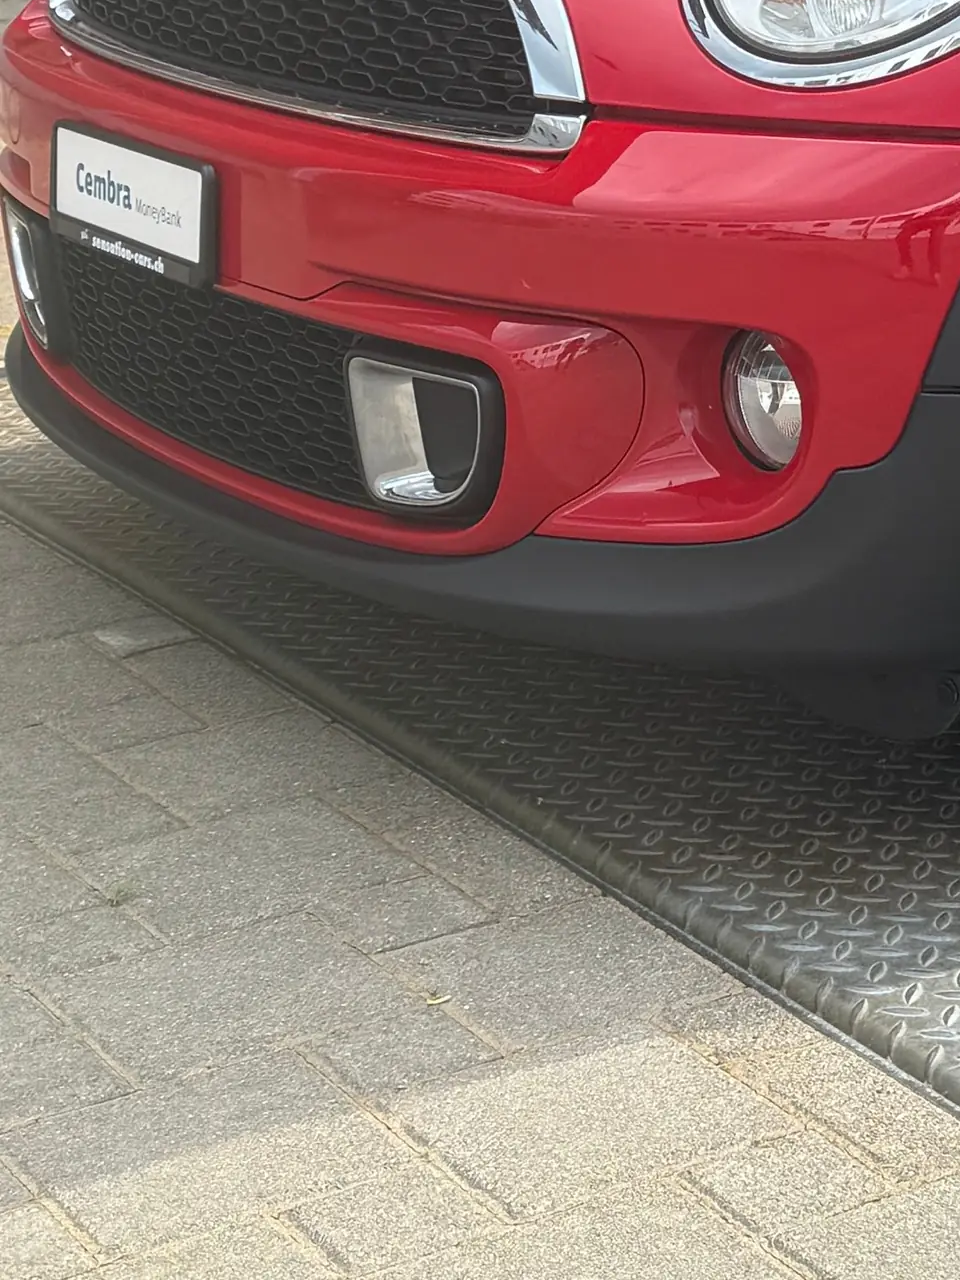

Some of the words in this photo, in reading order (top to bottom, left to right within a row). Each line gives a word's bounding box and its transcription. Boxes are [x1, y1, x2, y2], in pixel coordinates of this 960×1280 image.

[76, 162, 132, 210] Cembra
[135, 197, 182, 228] MoneyBank
[92, 234, 165, 275] sensation-cars.ch
